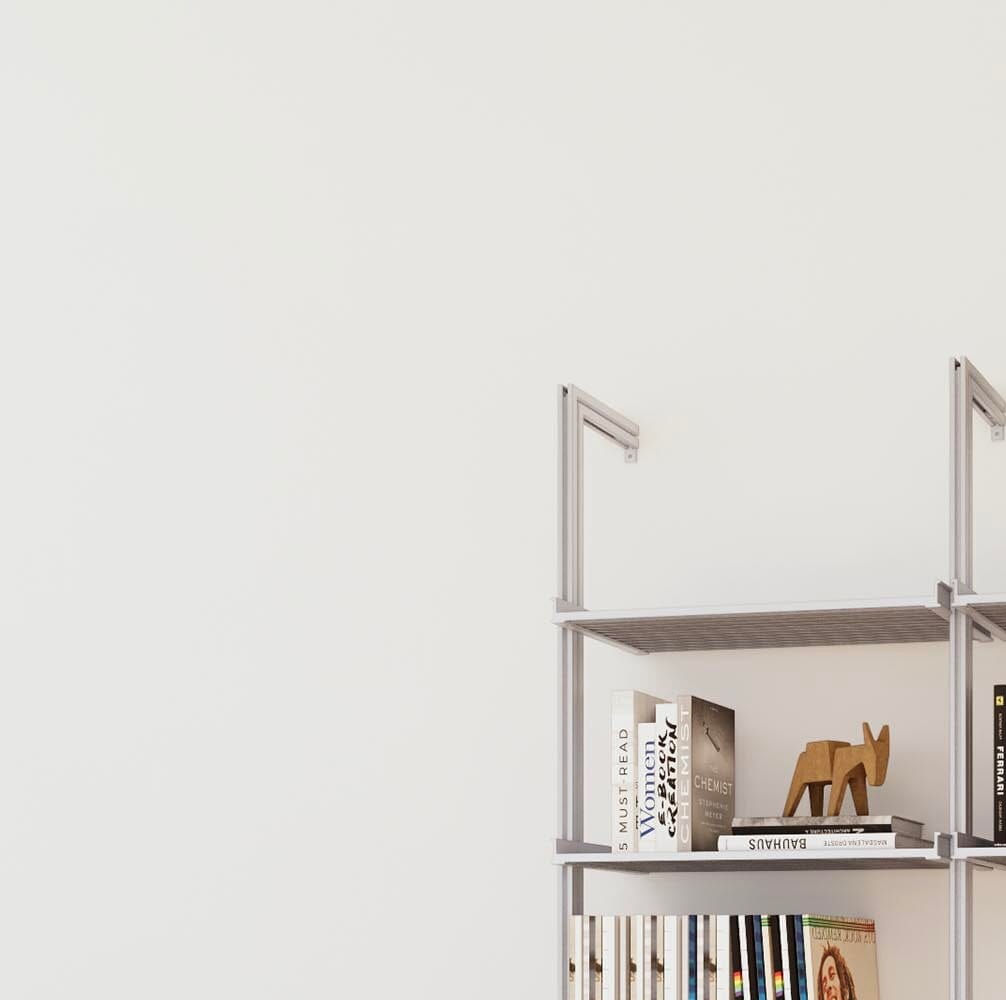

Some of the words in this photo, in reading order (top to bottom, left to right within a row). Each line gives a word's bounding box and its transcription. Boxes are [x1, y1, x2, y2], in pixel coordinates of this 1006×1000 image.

[640, 741, 655, 837] Women
[658, 729, 667, 826] E-BOOK
[665, 717, 678, 837] CREATION
[681, 704, 689, 843] CHEMIST
[694, 775, 732, 796] CHEMIST
[748, 838, 806, 850] BAUHAUS
